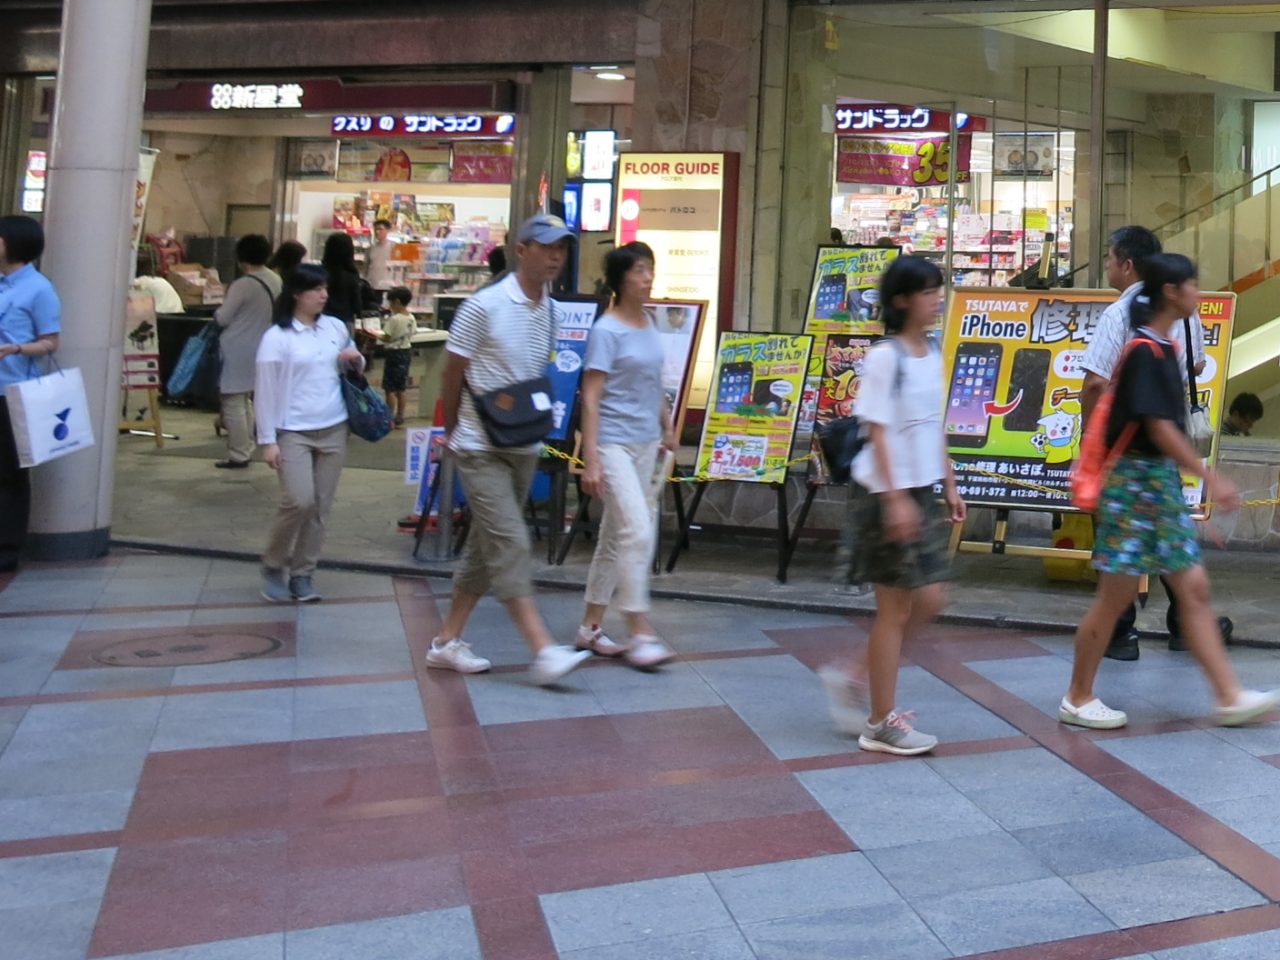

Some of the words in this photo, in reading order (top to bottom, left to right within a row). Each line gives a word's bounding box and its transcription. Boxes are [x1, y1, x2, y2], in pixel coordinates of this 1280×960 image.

[232, 84, 303, 109] 新星堂
[836, 108, 930, 129] サンドラッグ
[624, 162, 670, 175] FLOOR
[675, 162, 720, 175] GUIDE
[965, 299, 1029, 313] TSUTAYAで
[960, 313, 1027, 339] iPhone
[721, 341, 768, 363] ガラス
[767, 336, 800, 351] 割れて
